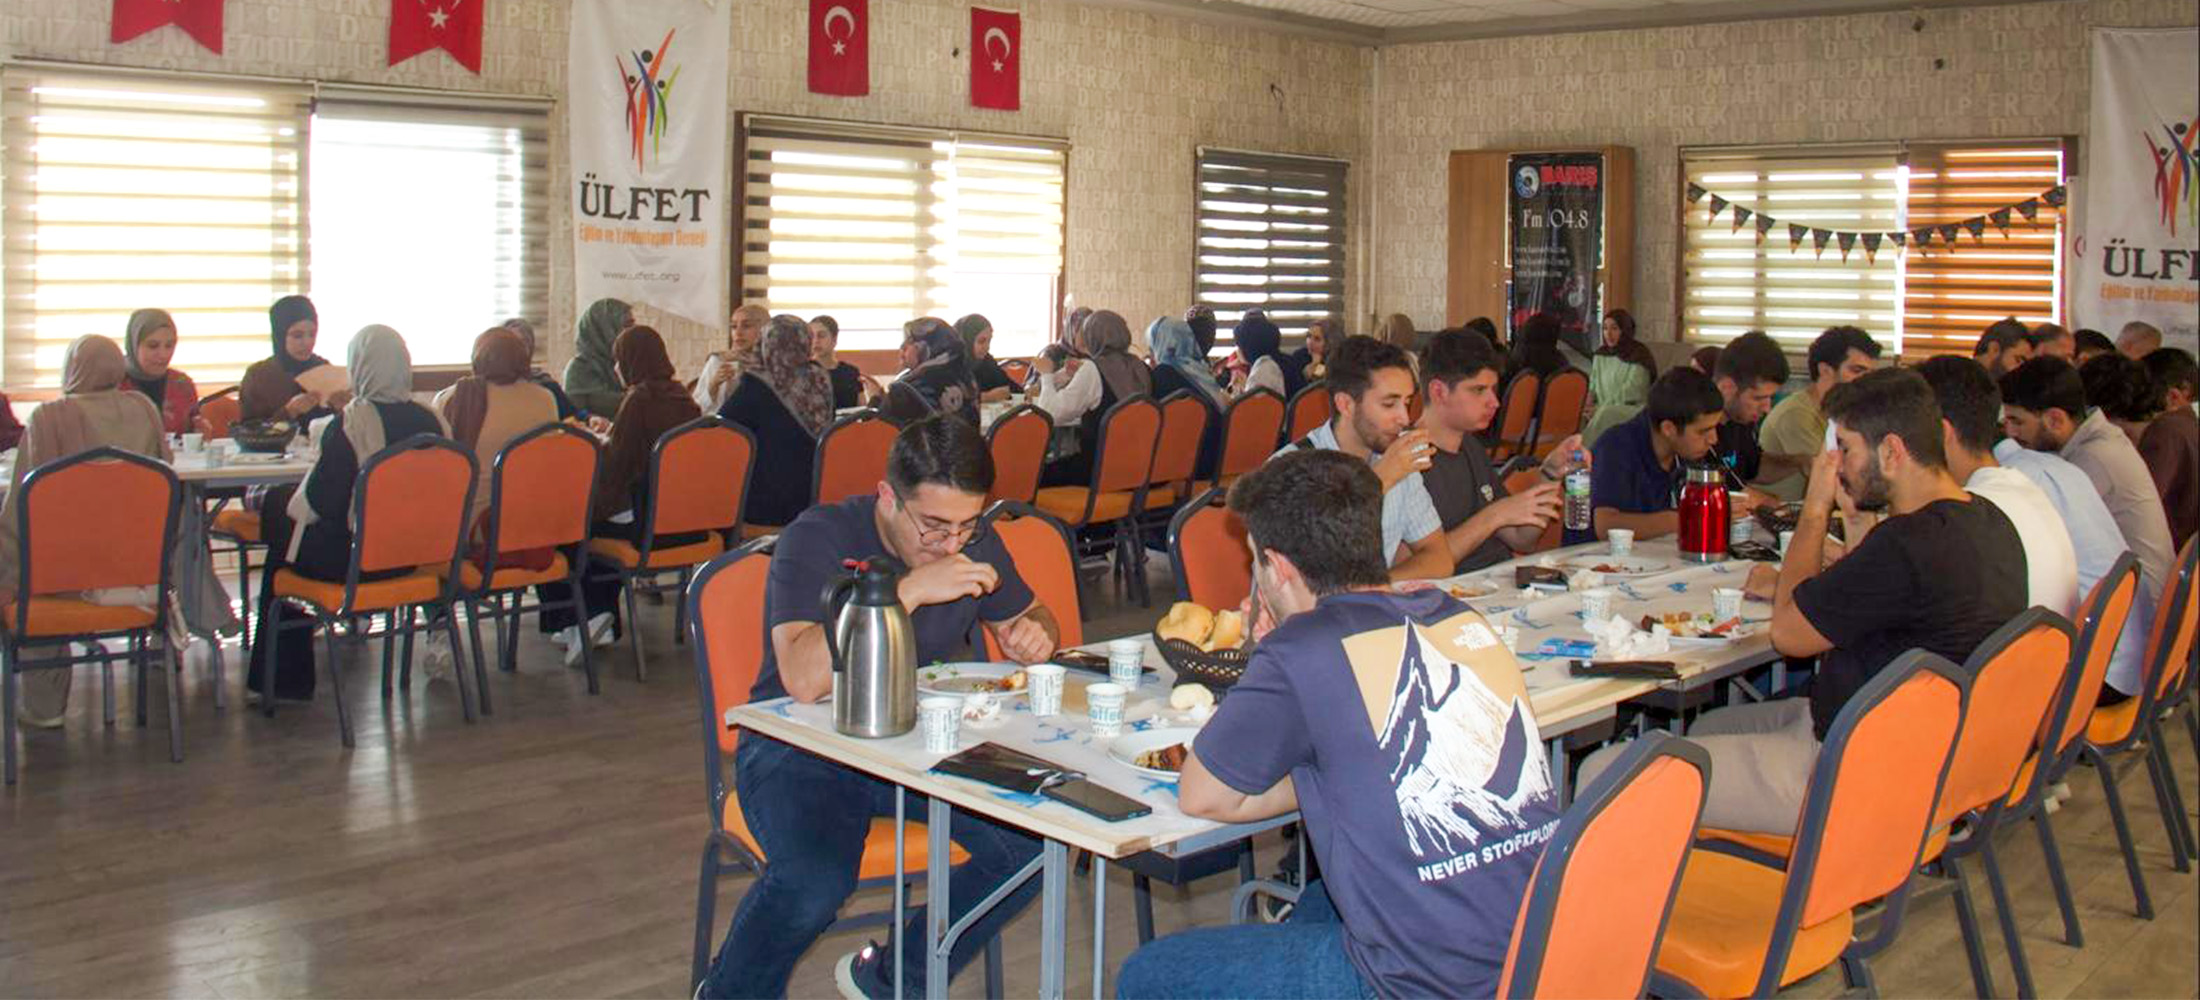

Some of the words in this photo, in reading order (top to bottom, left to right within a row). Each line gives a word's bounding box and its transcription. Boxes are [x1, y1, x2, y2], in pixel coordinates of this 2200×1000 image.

[580, 173, 710, 222] ÜLFET
[1523, 208, 1542, 228] Fm
[1546, 208, 1589, 229] 104.8
[1418, 852, 1478, 881] NEVER
[1482, 839, 1515, 864] STO
